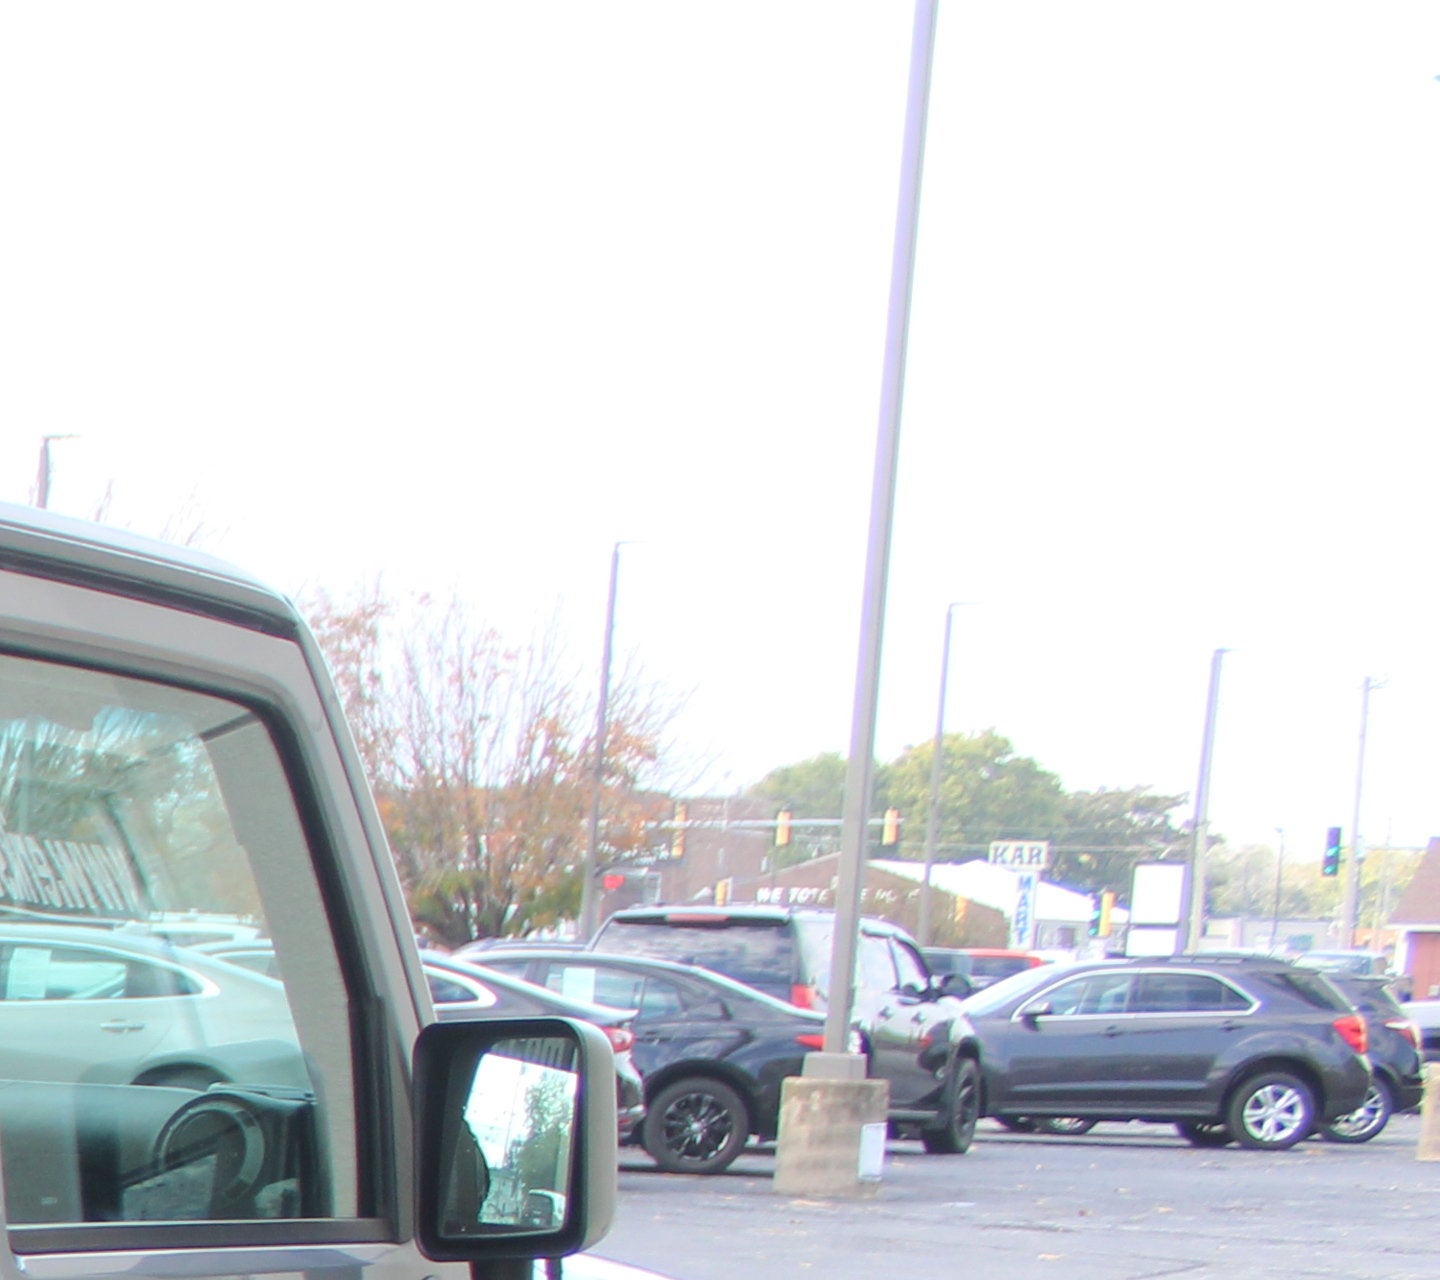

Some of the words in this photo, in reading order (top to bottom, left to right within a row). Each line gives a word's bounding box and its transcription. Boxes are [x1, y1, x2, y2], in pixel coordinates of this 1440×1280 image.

[990, 845, 1043, 866] KAR
[756, 887, 783, 903] WE
[1014, 875, 1033, 945] MART
